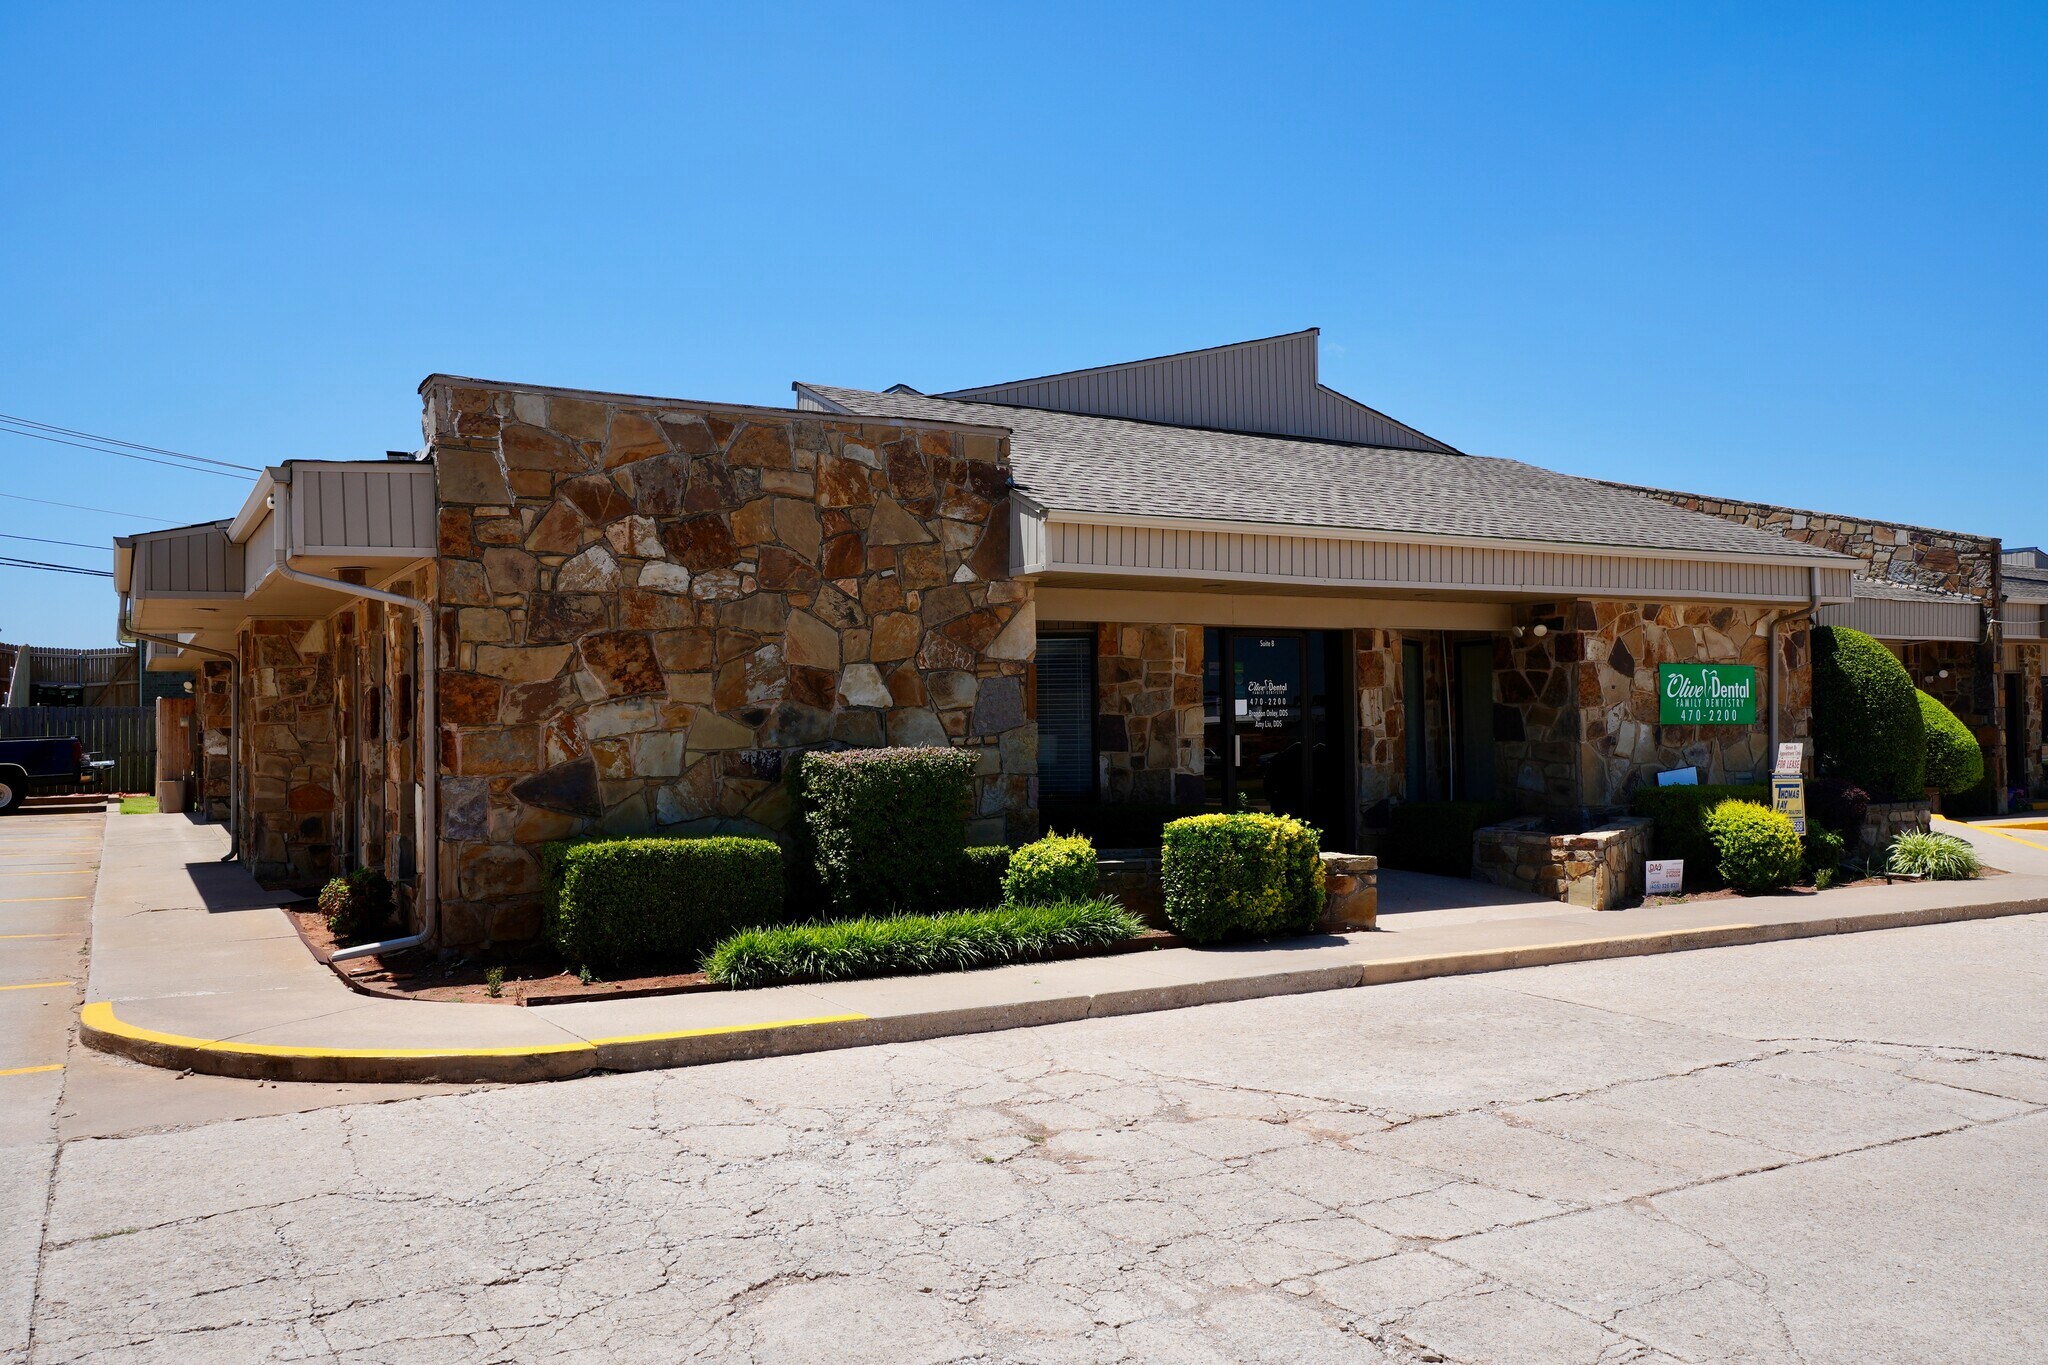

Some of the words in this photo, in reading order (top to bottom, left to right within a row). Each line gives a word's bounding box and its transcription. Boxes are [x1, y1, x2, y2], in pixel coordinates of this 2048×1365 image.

[1260, 639, 1270, 647] Suite
[1248, 681, 1266, 691] Olive
[1268, 682, 1287, 691] Dental
[1667, 673, 1704, 698] Olive
[1711, 676, 1750, 698] Dental
[1675, 698, 1702, 708] FAMILY
[1705, 698, 1745, 708] DENTISTRY
[1681, 709, 1737, 722] 470-2200
[1273, 720, 1282, 728] DDS
[1777, 760, 1786, 768] FOR
[1786, 760, 1800, 768] LEASE
[1775, 783, 1800, 799] THOMAS
